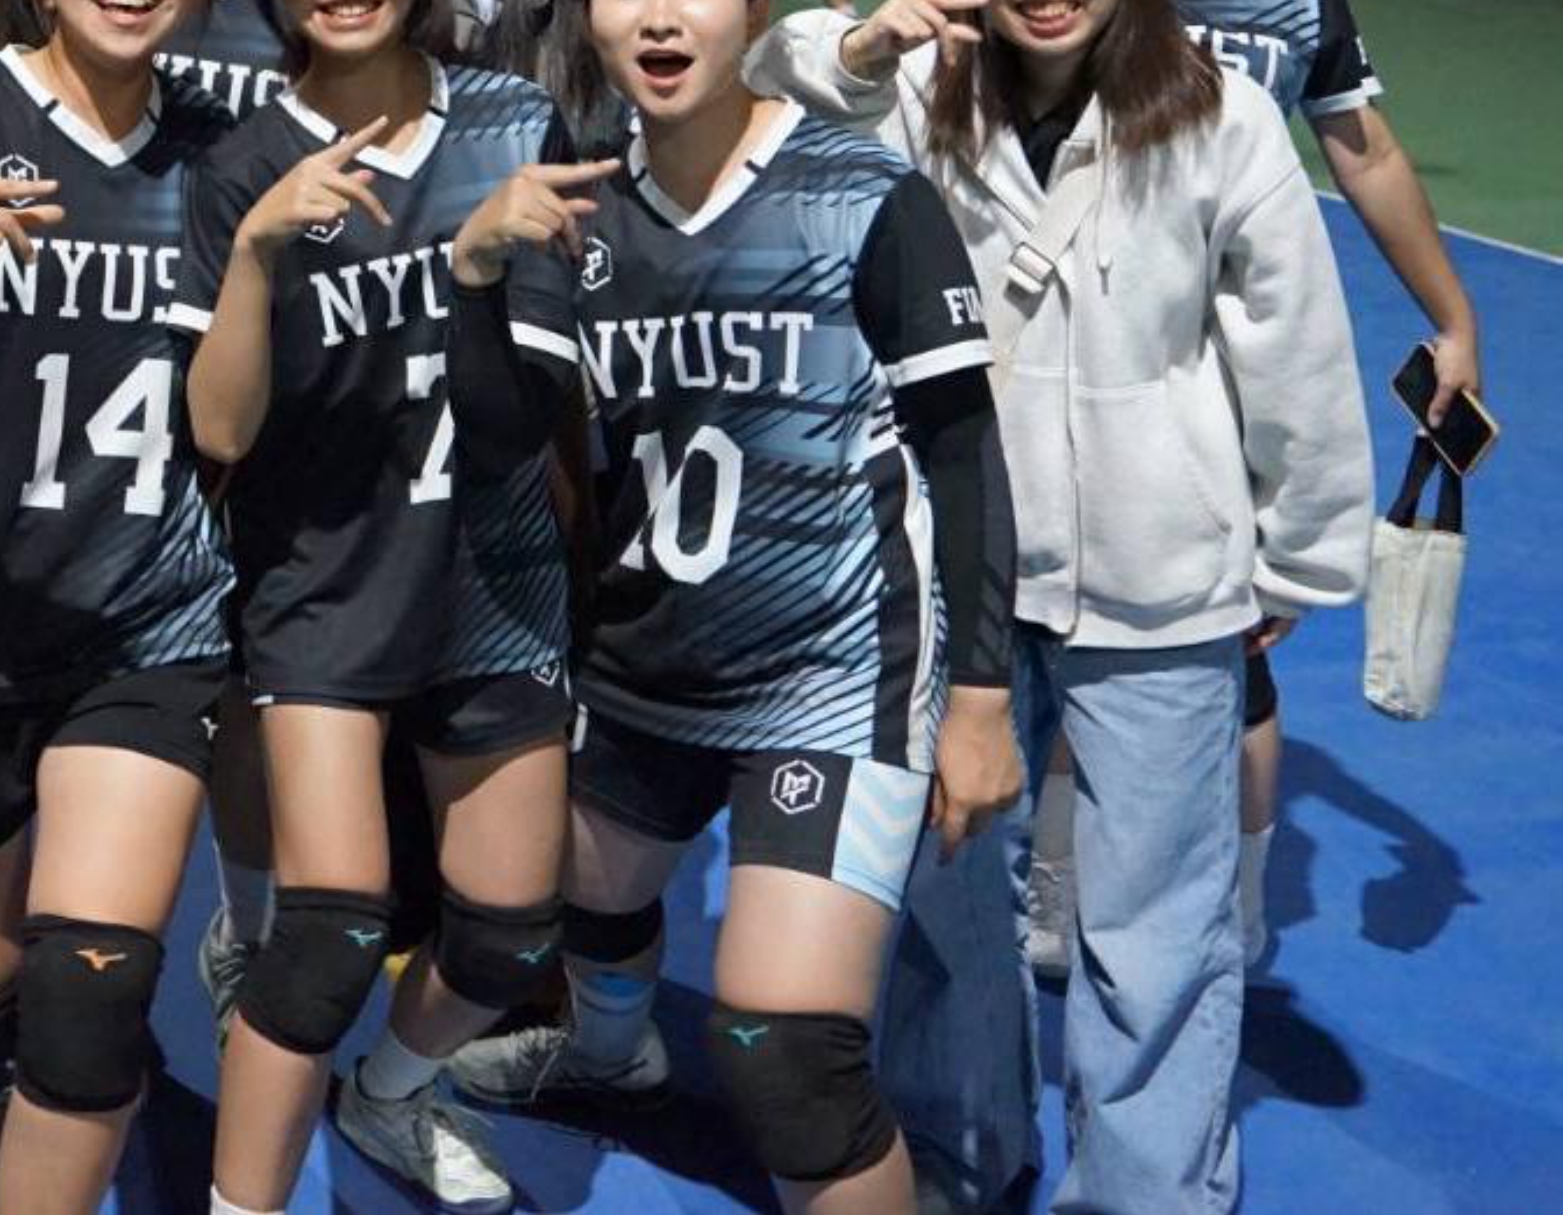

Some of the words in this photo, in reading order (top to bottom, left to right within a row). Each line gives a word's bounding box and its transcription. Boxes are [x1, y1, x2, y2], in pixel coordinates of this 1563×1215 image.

[310, 241, 455, 348] NYU
[577, 310, 814, 399] NYUST
[19, 353, 174, 516] 14
[619, 424, 743, 585] 10
